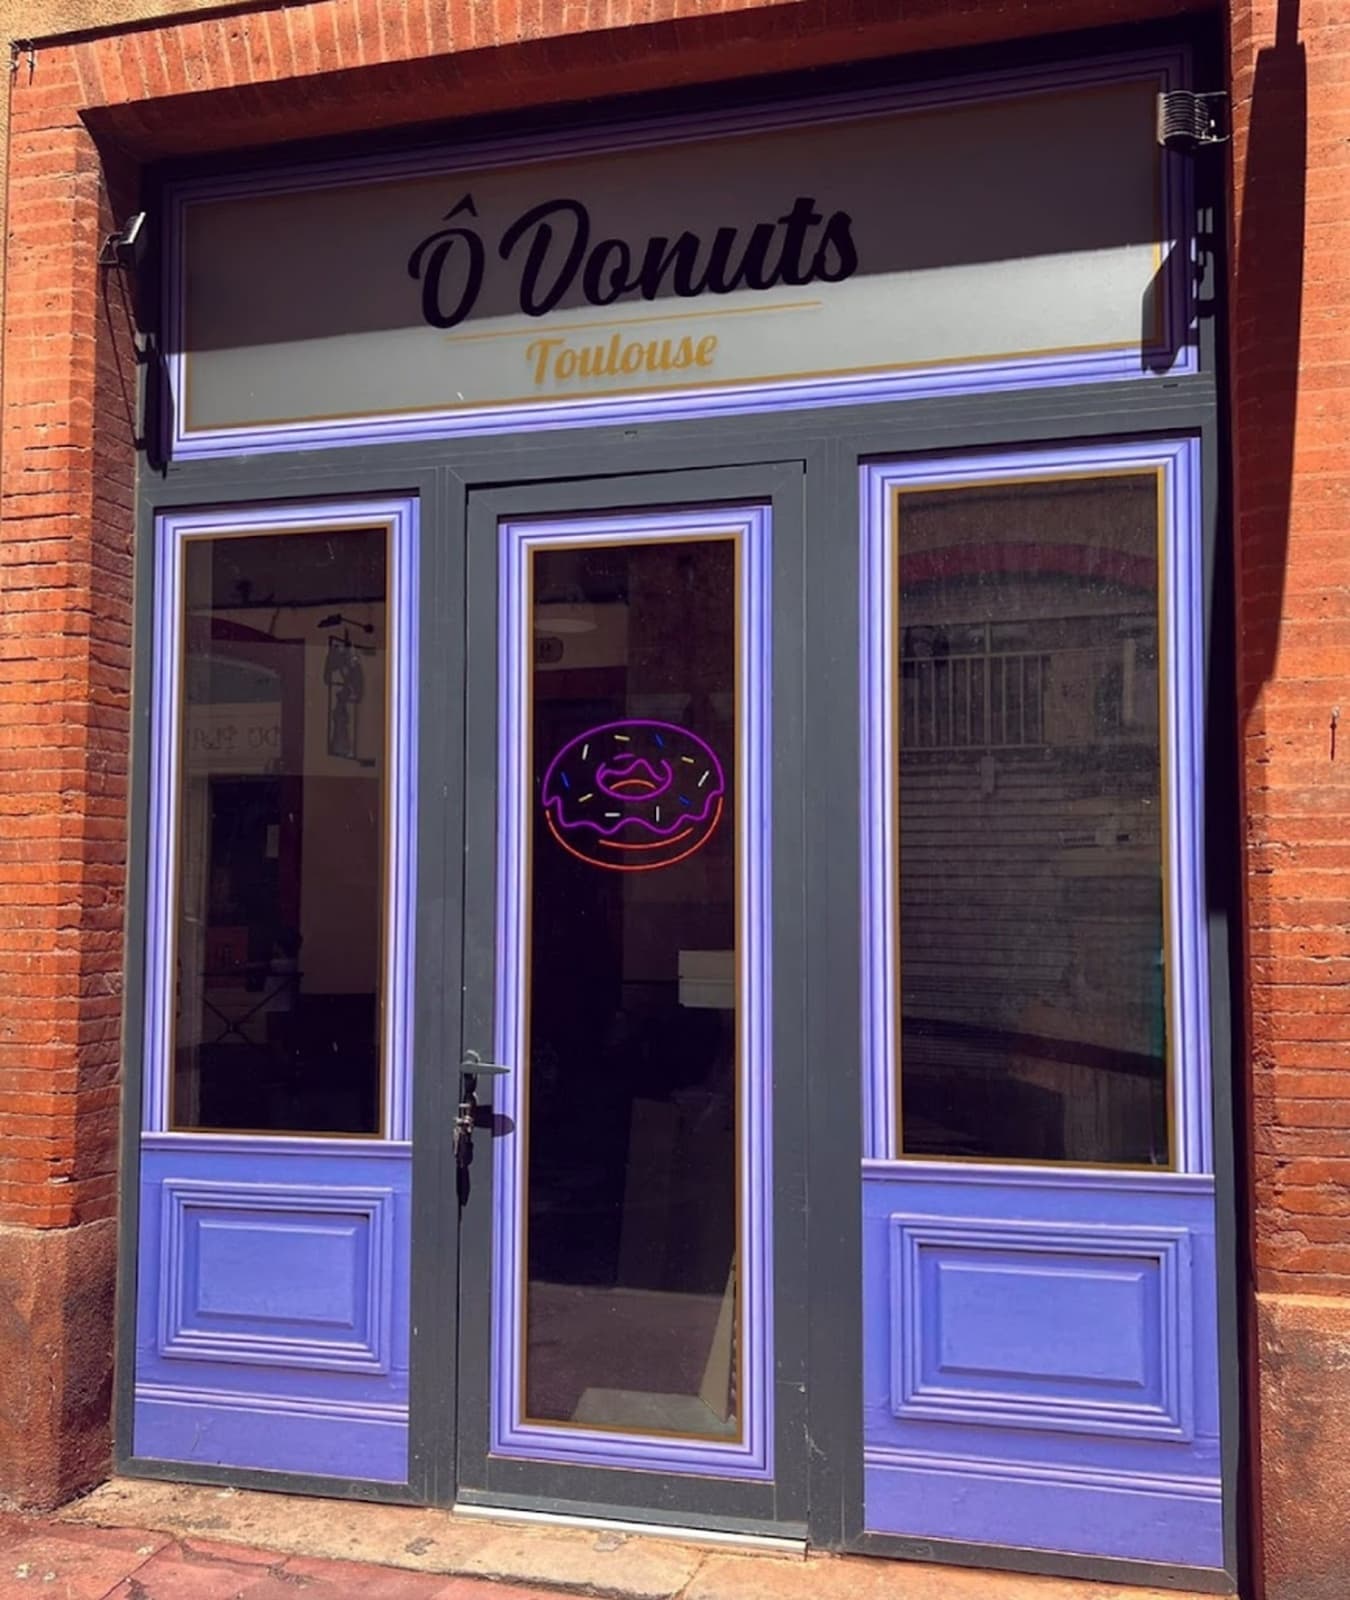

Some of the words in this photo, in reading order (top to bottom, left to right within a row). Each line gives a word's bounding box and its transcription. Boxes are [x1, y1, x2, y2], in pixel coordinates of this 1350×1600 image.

[407, 194, 485, 329] Ô
[499, 197, 858, 317] Donuts
[525, 334, 719, 385] Toulouse
